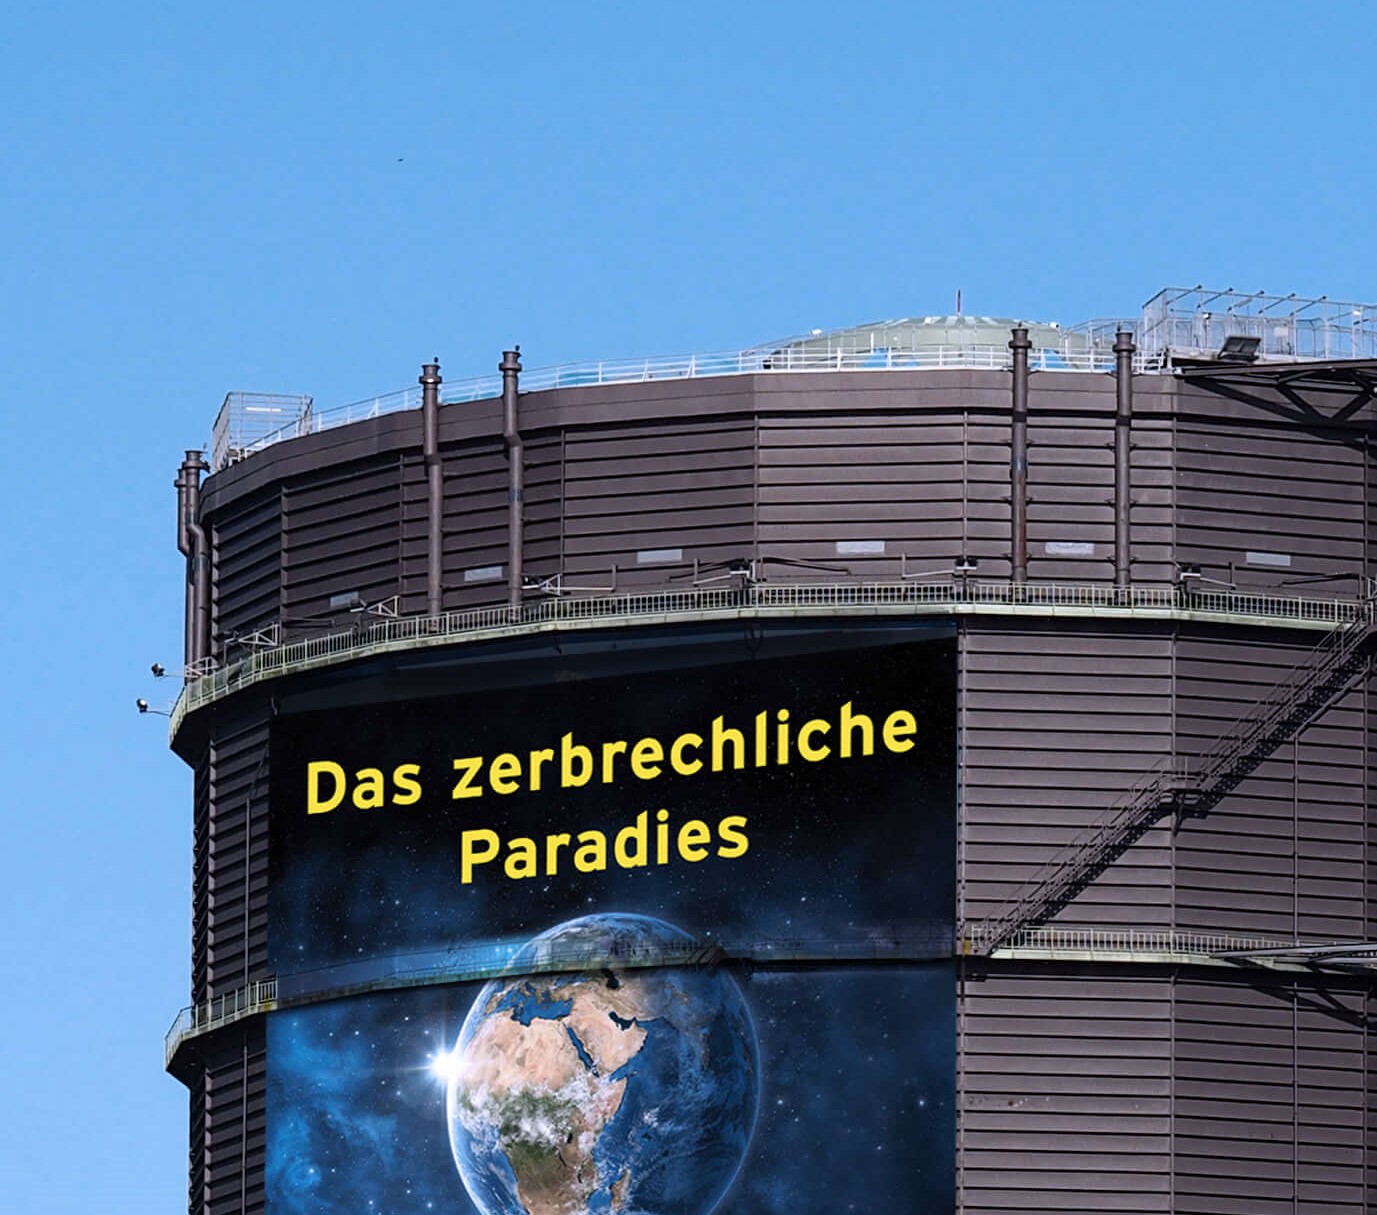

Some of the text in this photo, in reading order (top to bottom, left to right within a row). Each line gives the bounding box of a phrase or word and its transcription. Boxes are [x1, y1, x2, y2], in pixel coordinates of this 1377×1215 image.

[307, 701, 917, 815] Das zerbrechliche
[460, 808, 749, 884] Paradies
